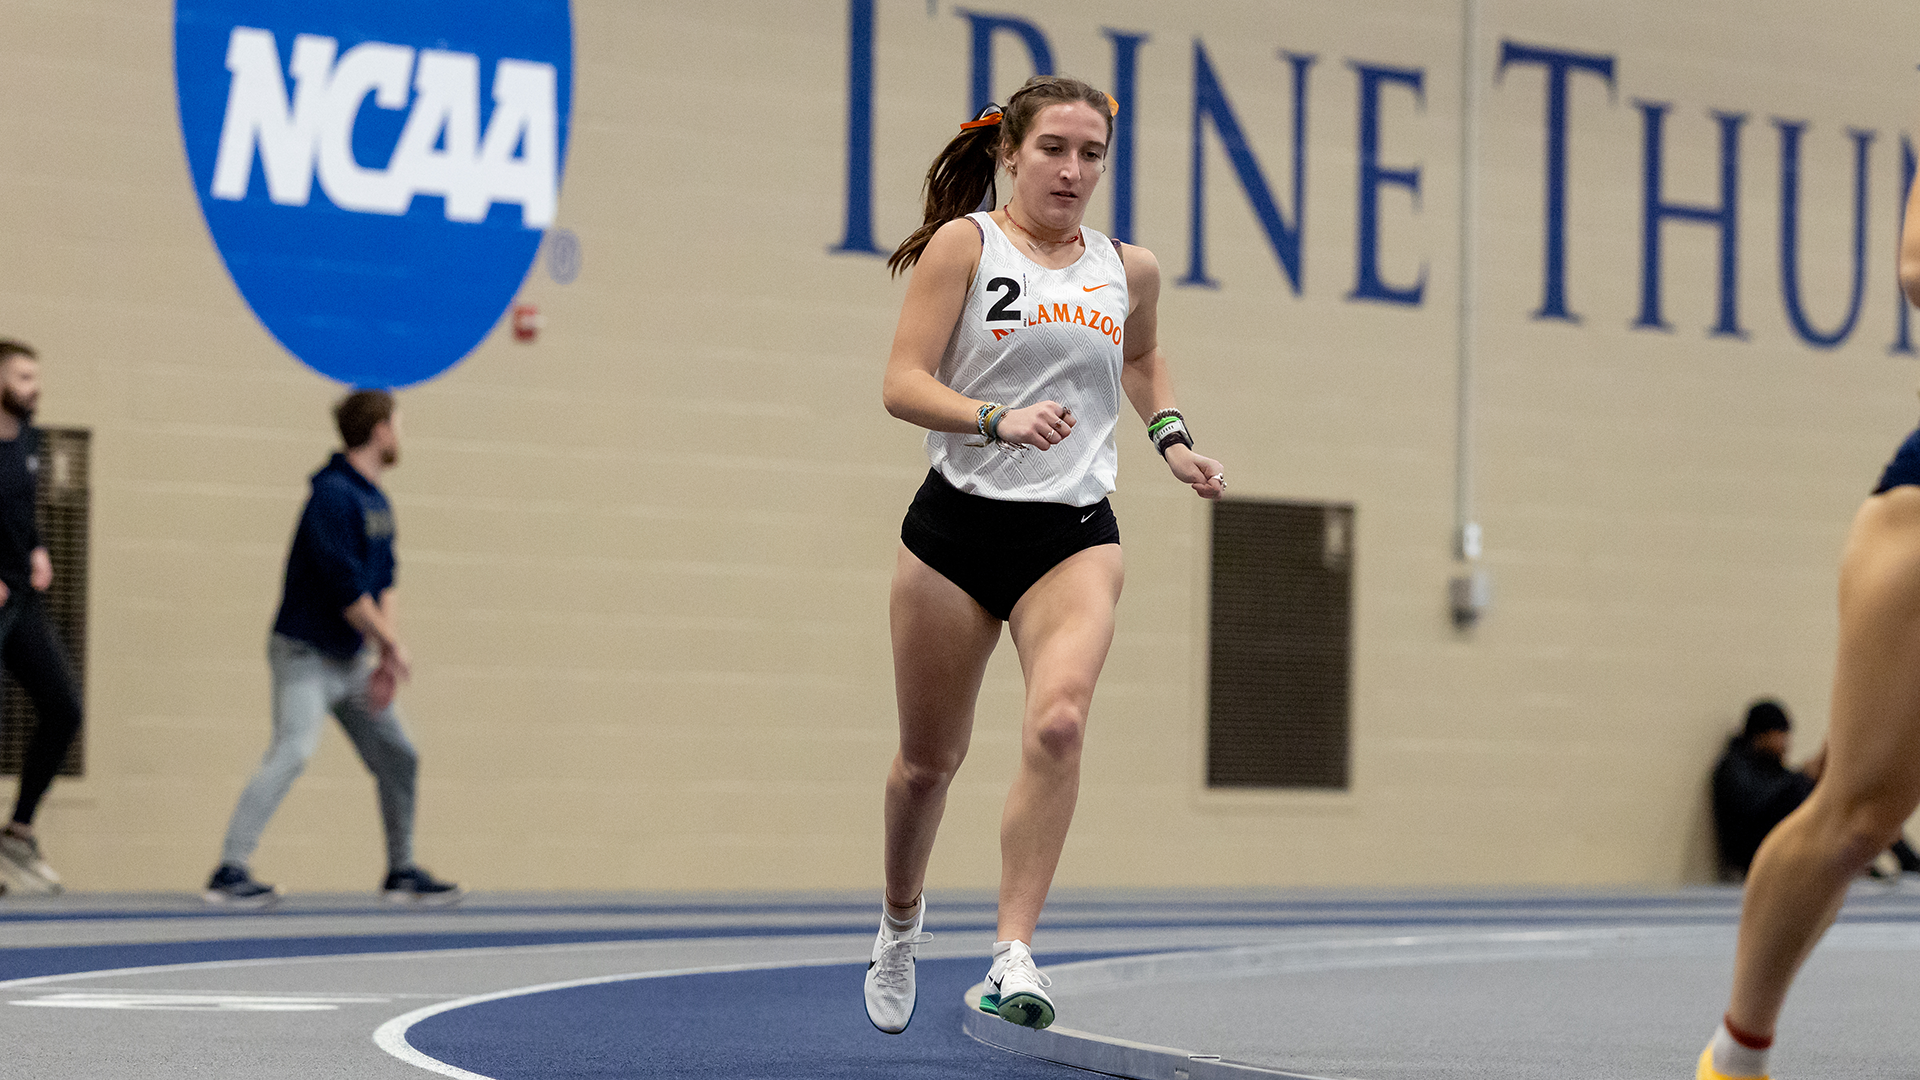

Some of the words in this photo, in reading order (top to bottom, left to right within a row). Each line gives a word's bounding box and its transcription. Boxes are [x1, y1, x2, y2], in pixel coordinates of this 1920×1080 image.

[211, 26, 557, 230] NCAA
[986, 277, 1021, 321] 2
[991, 303, 1122, 345] KLAMAZOO
